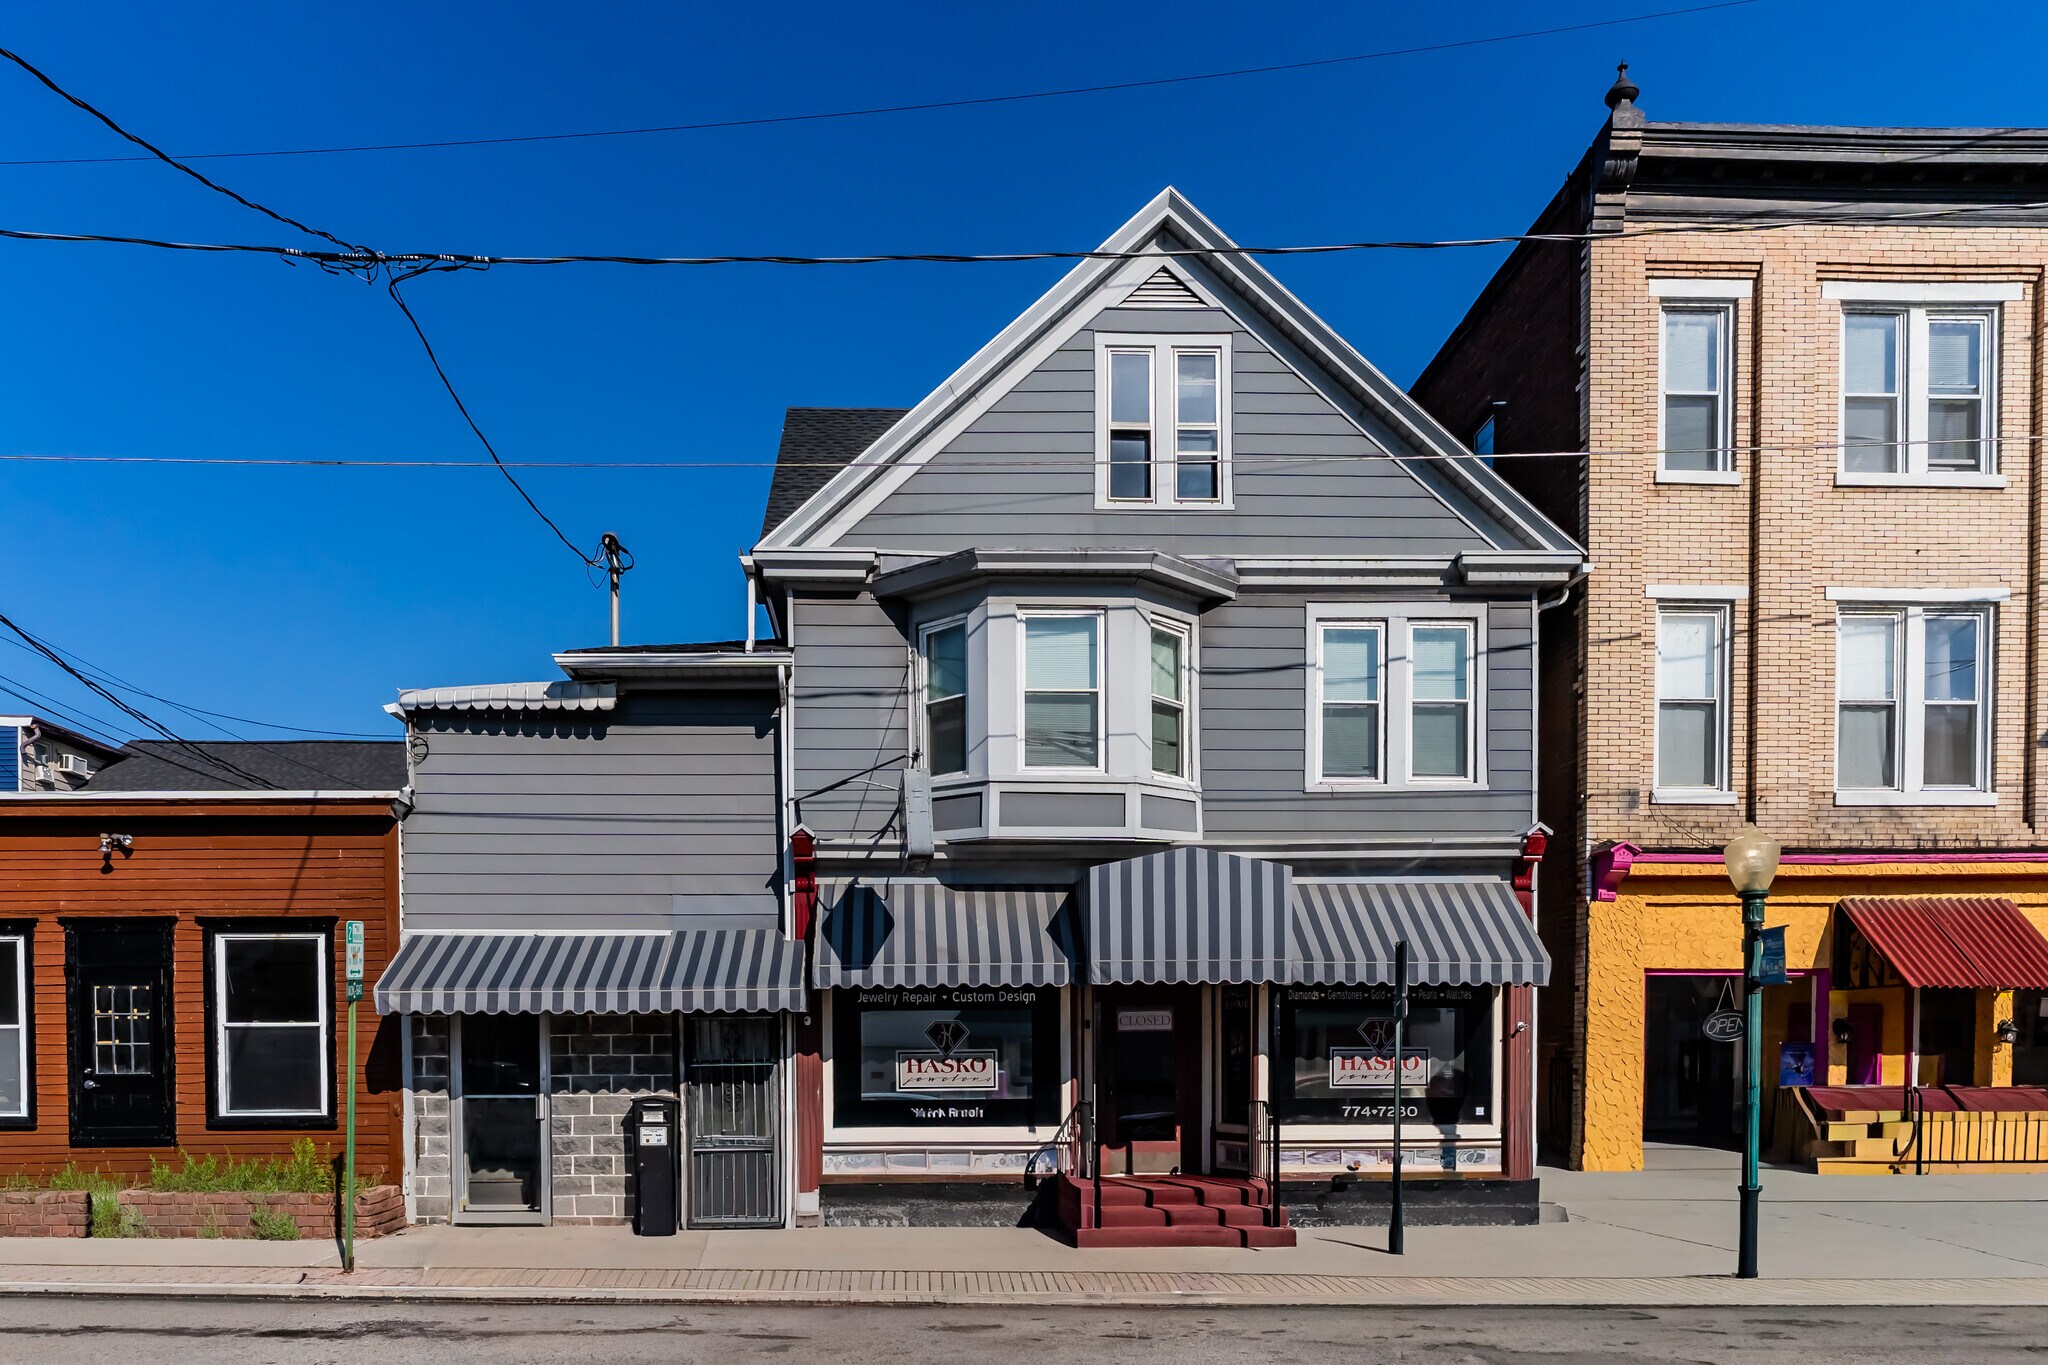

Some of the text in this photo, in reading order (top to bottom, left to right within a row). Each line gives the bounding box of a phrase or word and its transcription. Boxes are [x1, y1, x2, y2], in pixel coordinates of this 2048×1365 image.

[857, 990, 1036, 1005] Jewelry Repair Custom Design
[1287, 989, 1472, 1000] Diamonds Gemstones Gold Pearls Watches
[1119, 1014, 1171, 1026] CLOSED
[907, 1057, 987, 1074] HASKO
[902, 1074, 992, 1086] jewelers
[1336, 1071, 1424, 1083] jewelrs
